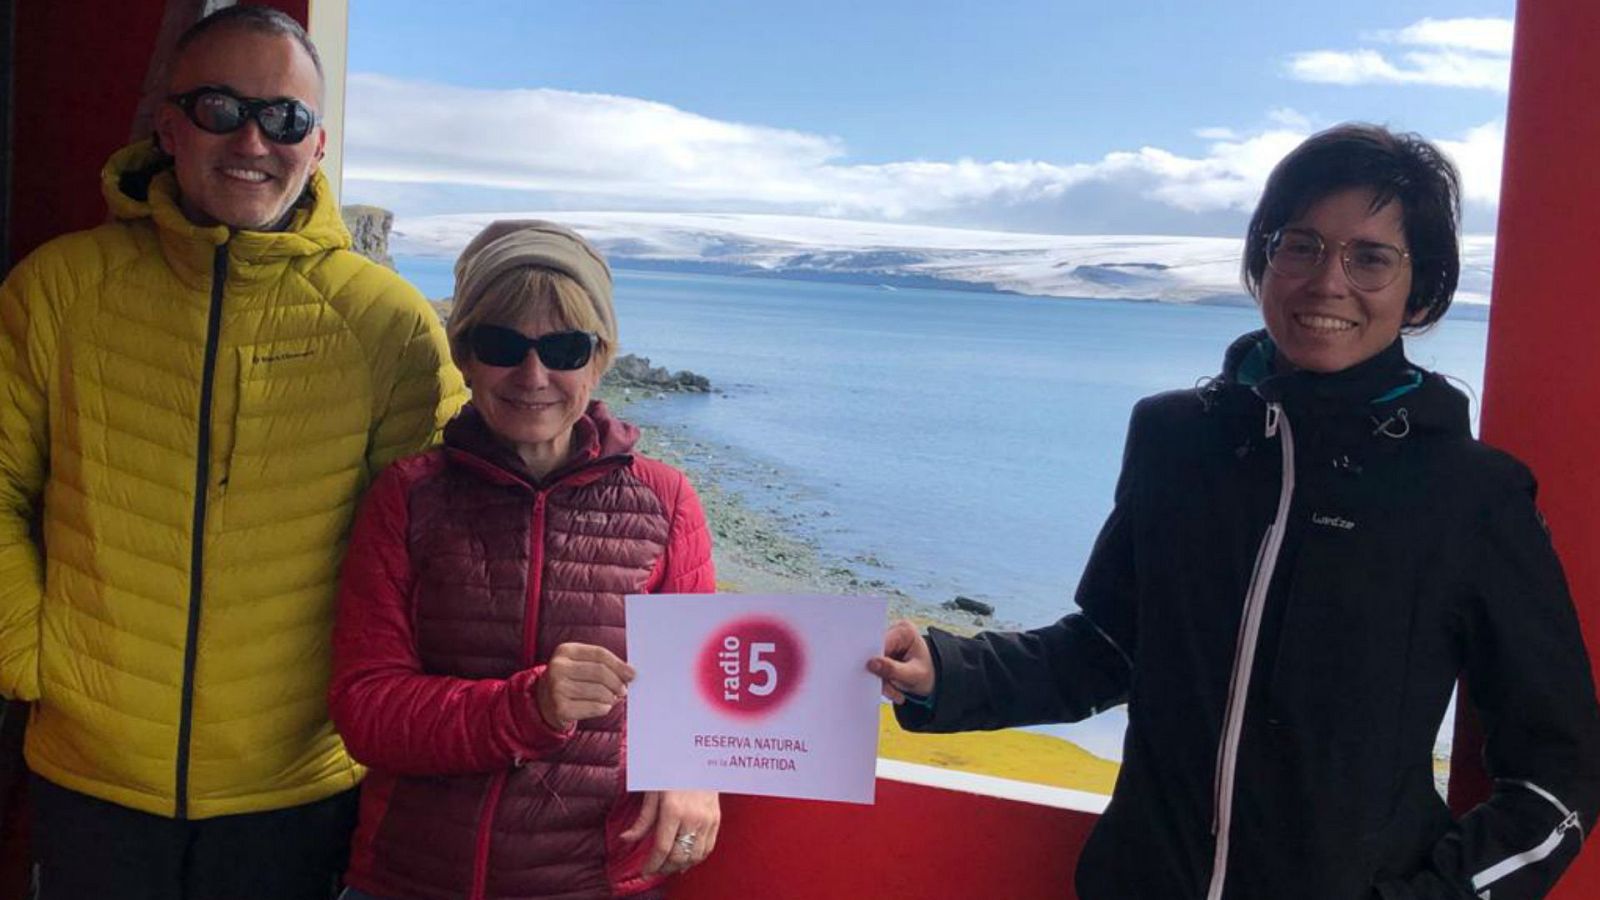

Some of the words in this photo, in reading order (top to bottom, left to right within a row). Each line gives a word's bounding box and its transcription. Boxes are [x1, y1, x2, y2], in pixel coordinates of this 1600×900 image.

[719, 636, 740, 702] radio
[748, 643, 778, 696] 5
[694, 735, 752, 749] RESERVA
[754, 738, 809, 753] NATURAL
